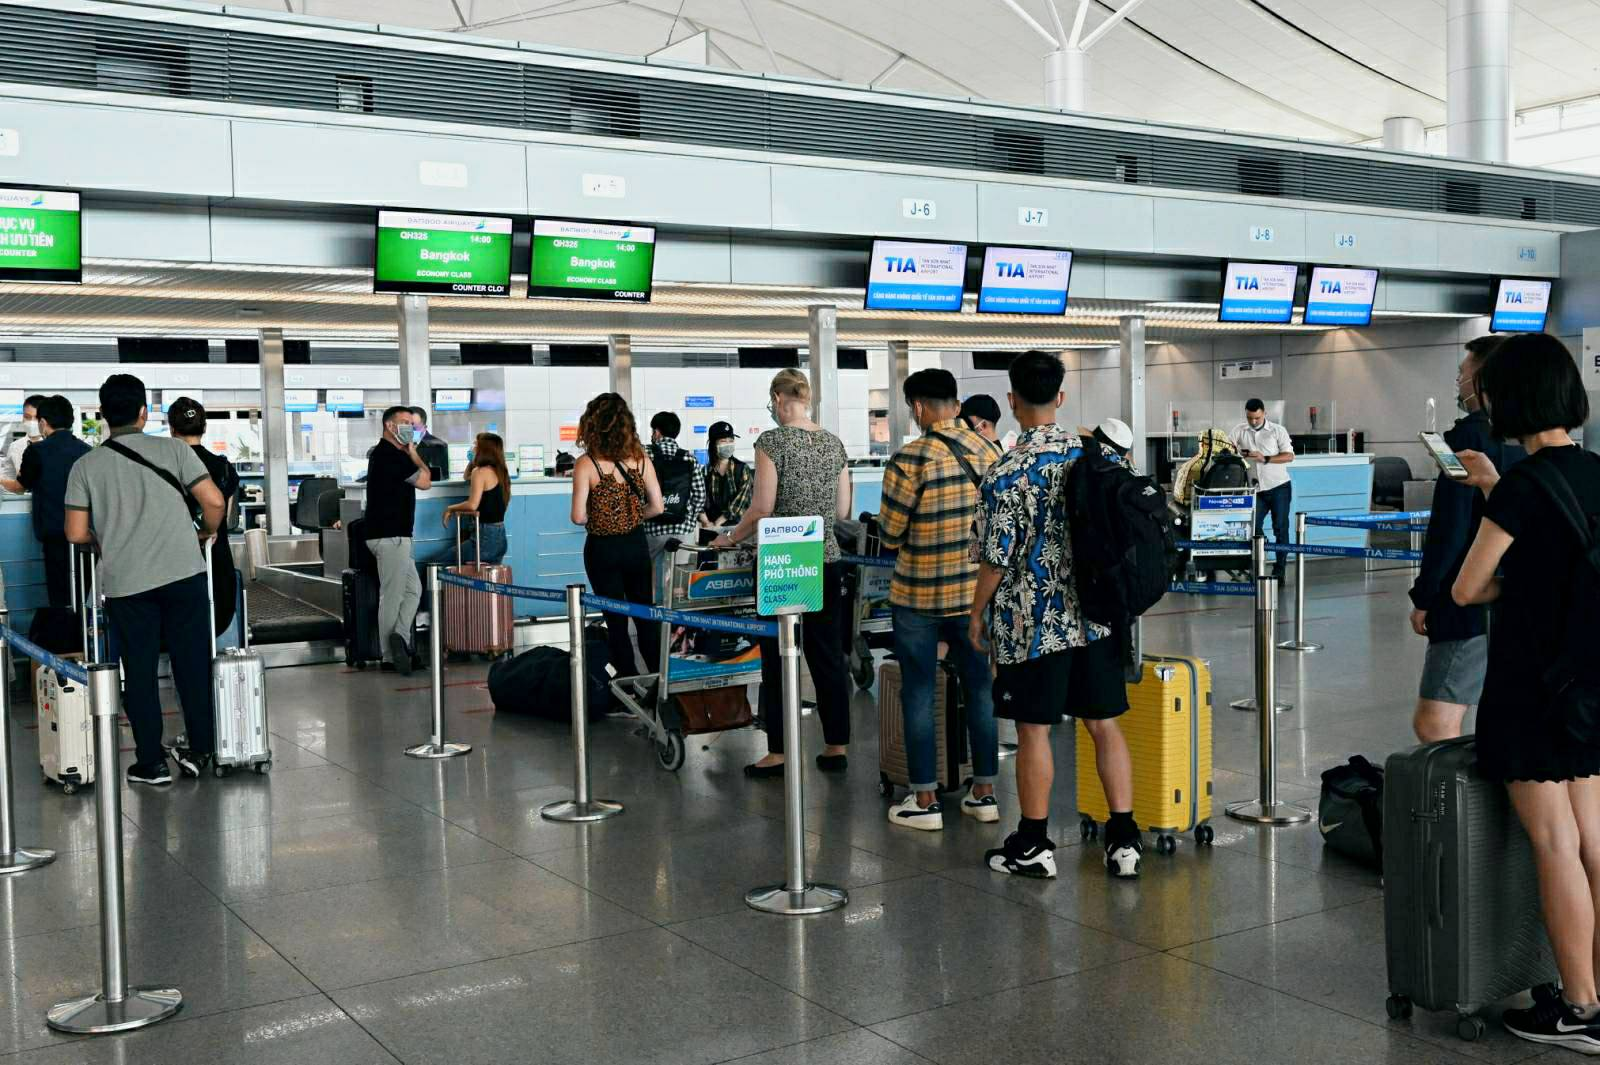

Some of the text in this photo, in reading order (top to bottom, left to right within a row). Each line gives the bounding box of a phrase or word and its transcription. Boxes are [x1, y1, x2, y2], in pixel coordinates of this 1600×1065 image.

[910, 203, 930, 216] J-6
[1025, 211, 1043, 224] J-7
[470, 235, 492, 244] 14:00
[1255, 229, 1270, 240] J-8
[1339, 235, 1353, 247] J-9
[616, 244, 635, 252] 14:00
[420, 248, 470, 263] Bangkok
[570, 255, 616, 269] Bangkok
[884, 256, 916, 273] TIA
[416, 270, 473, 279] ECONOMY CLASS
[995, 261, 1025, 278] TIA
[597, 277, 617, 285] CLASS
[1235, 275, 1259, 290] TIA
[1319, 279, 1342, 294] TIA
[452, 284, 486, 292] COUNTER
[614, 291, 645, 299] COUNTER
[1504, 290, 1522, 304] TIA
[764, 525, 804, 535] BAMBOO
[1364, 549, 1383, 558] TIA
[764, 554, 791, 568] HẠNG
[785, 564, 818, 578] THÔNG
[764, 583, 799, 593] ECONOMY
[764, 595, 787, 604] CLASS
[649, 608, 663, 619] TIA
[712, 619, 746, 629] INTERNATIONAL
[747, 624, 767, 632] AIRPORT
